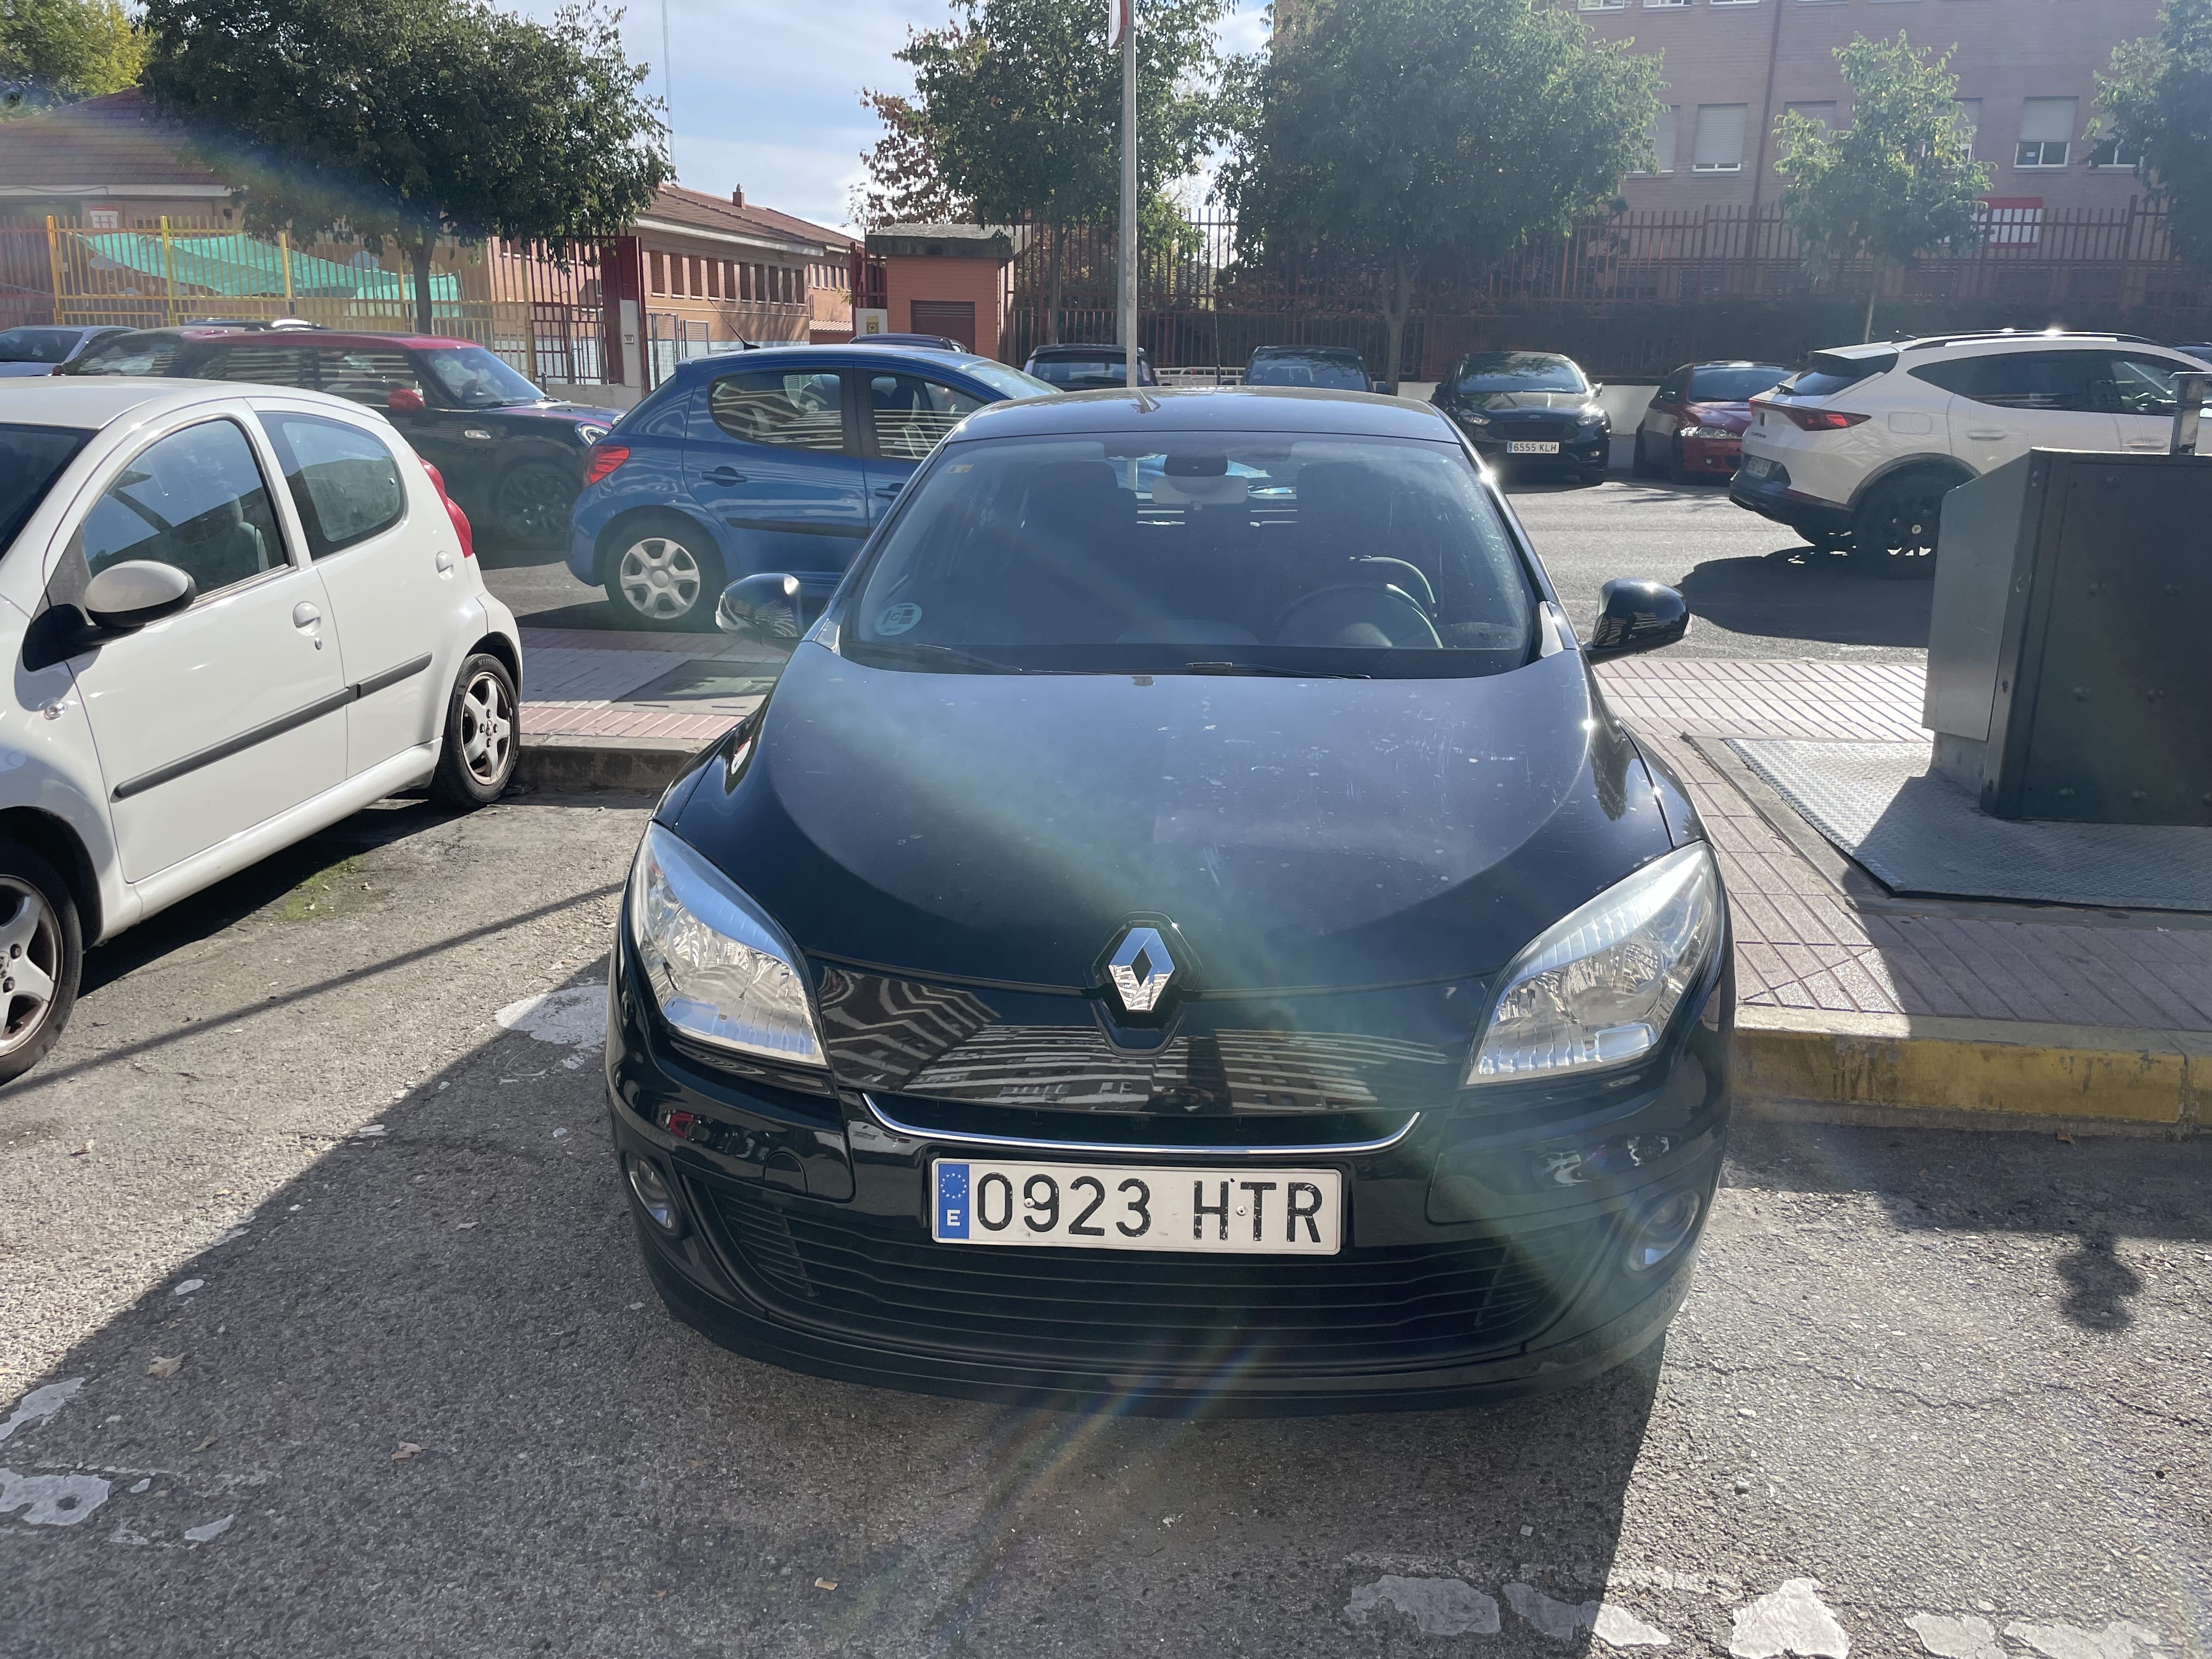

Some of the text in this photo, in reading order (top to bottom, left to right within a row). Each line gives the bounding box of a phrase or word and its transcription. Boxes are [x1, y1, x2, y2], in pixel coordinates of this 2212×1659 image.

[1514, 443, 1536, 452] 6555
[1539, 444, 1556, 452] KLH
[946, 1172, 1322, 1243] E 0923 HTR
